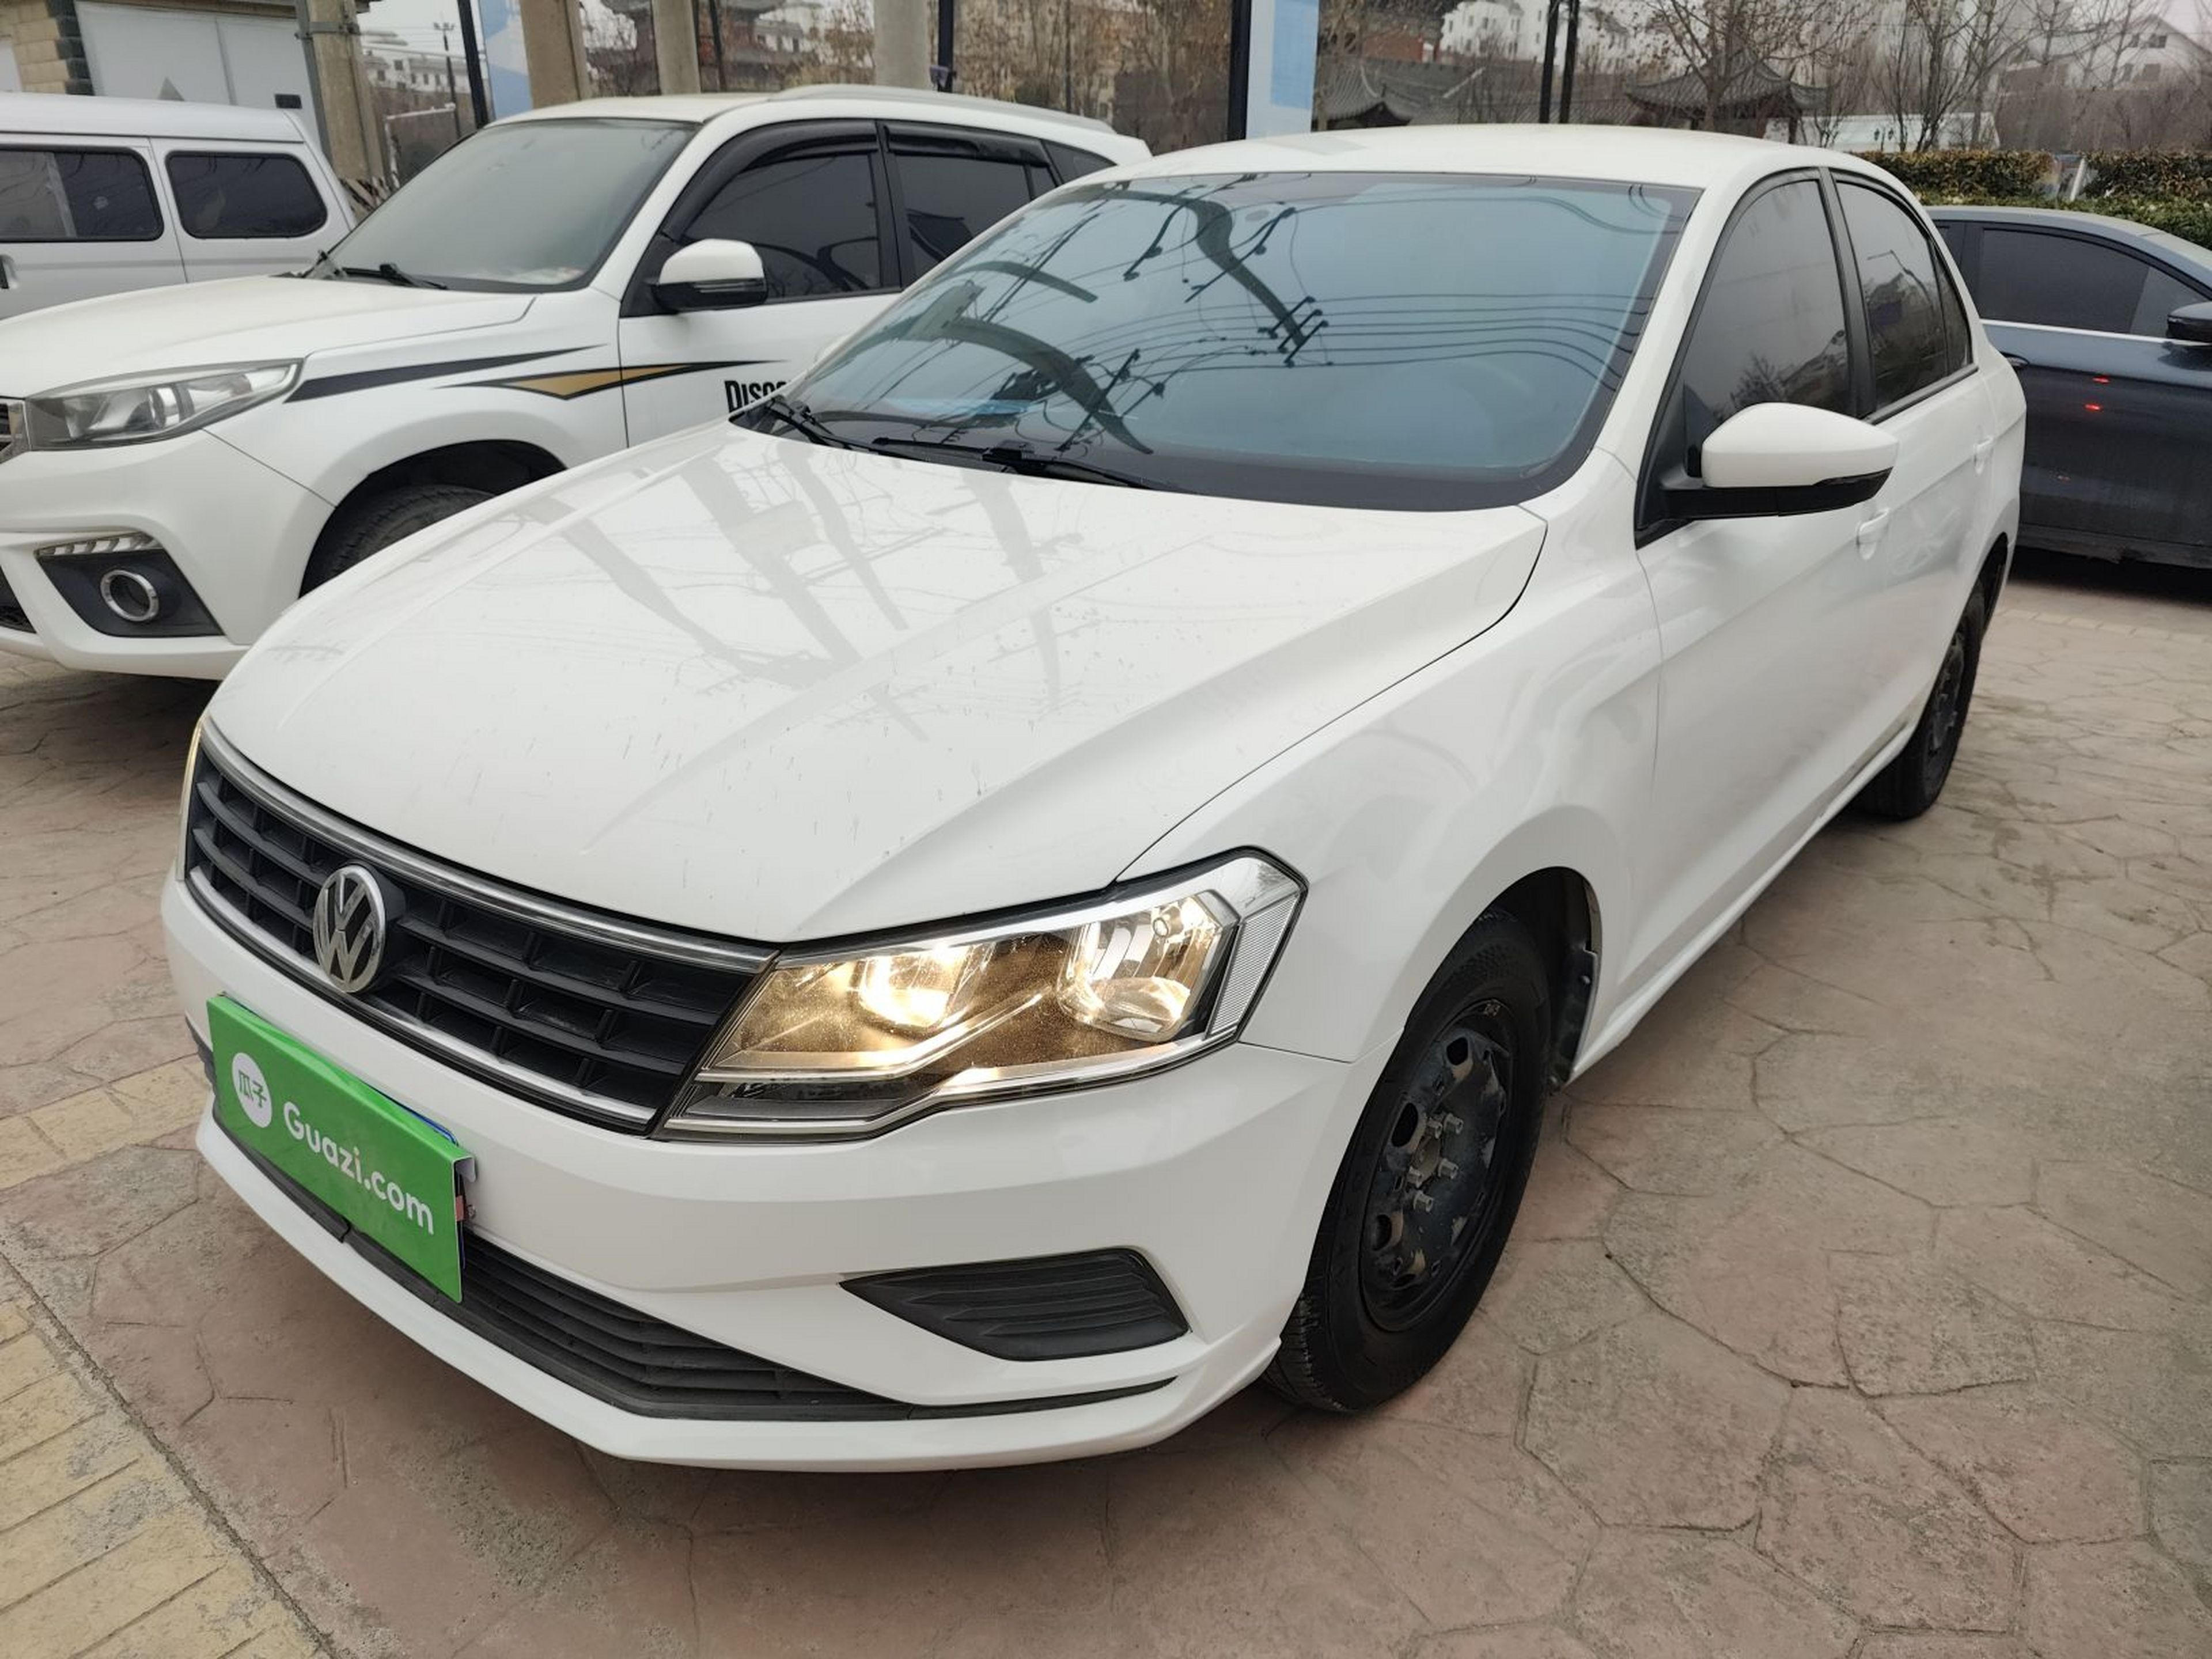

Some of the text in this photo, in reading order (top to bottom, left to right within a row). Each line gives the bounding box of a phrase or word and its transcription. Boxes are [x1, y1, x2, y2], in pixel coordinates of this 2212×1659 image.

[725, 381, 787, 413] DIS
[238, 1070, 267, 1108] 瓜子
[283, 1101, 434, 1235] Guazi.com
